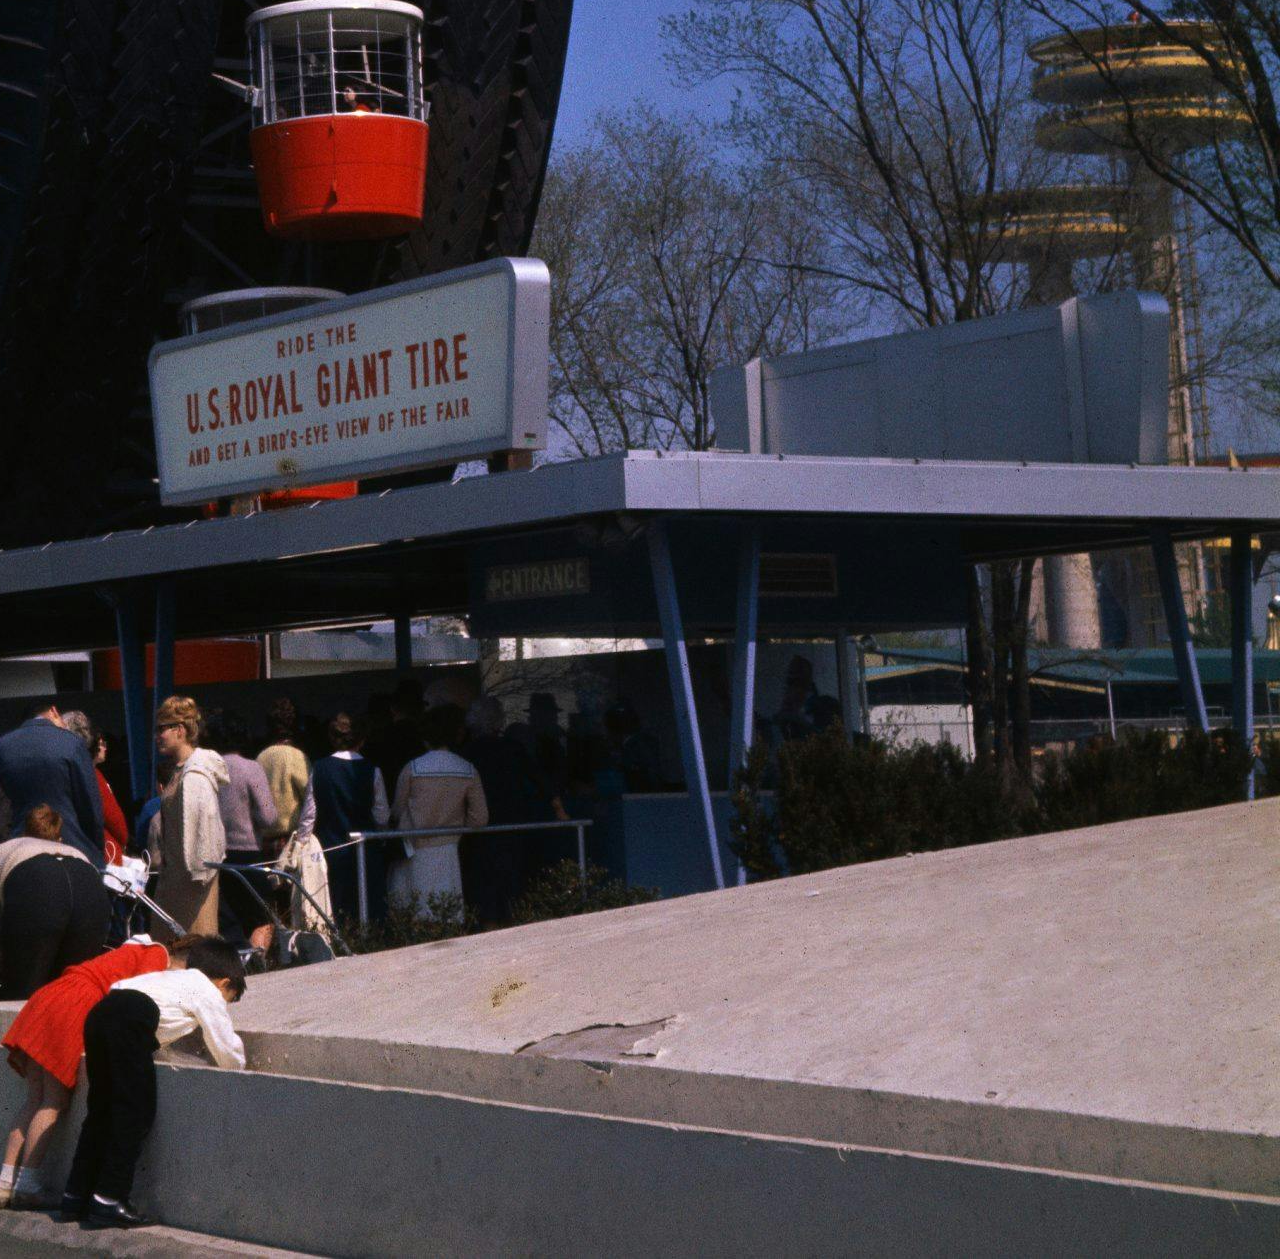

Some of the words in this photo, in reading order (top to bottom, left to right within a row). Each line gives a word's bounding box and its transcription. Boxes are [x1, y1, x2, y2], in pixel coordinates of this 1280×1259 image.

[277, 332, 315, 359] RIDE
[325, 323, 356, 347] THE
[317, 349, 392, 408] GIANT
[406, 332, 468, 391] TIRE
[188, 446, 210, 467] AND
[217, 442, 237, 462] GET
[244, 439, 251, 457] A
[336, 416, 370, 440] VIEW
[378, 412, 395, 432] OF
[401, 405, 427, 428] THE
[436, 397, 470, 422] FAIR
[502, 561, 585, 596] ENTRANCE
